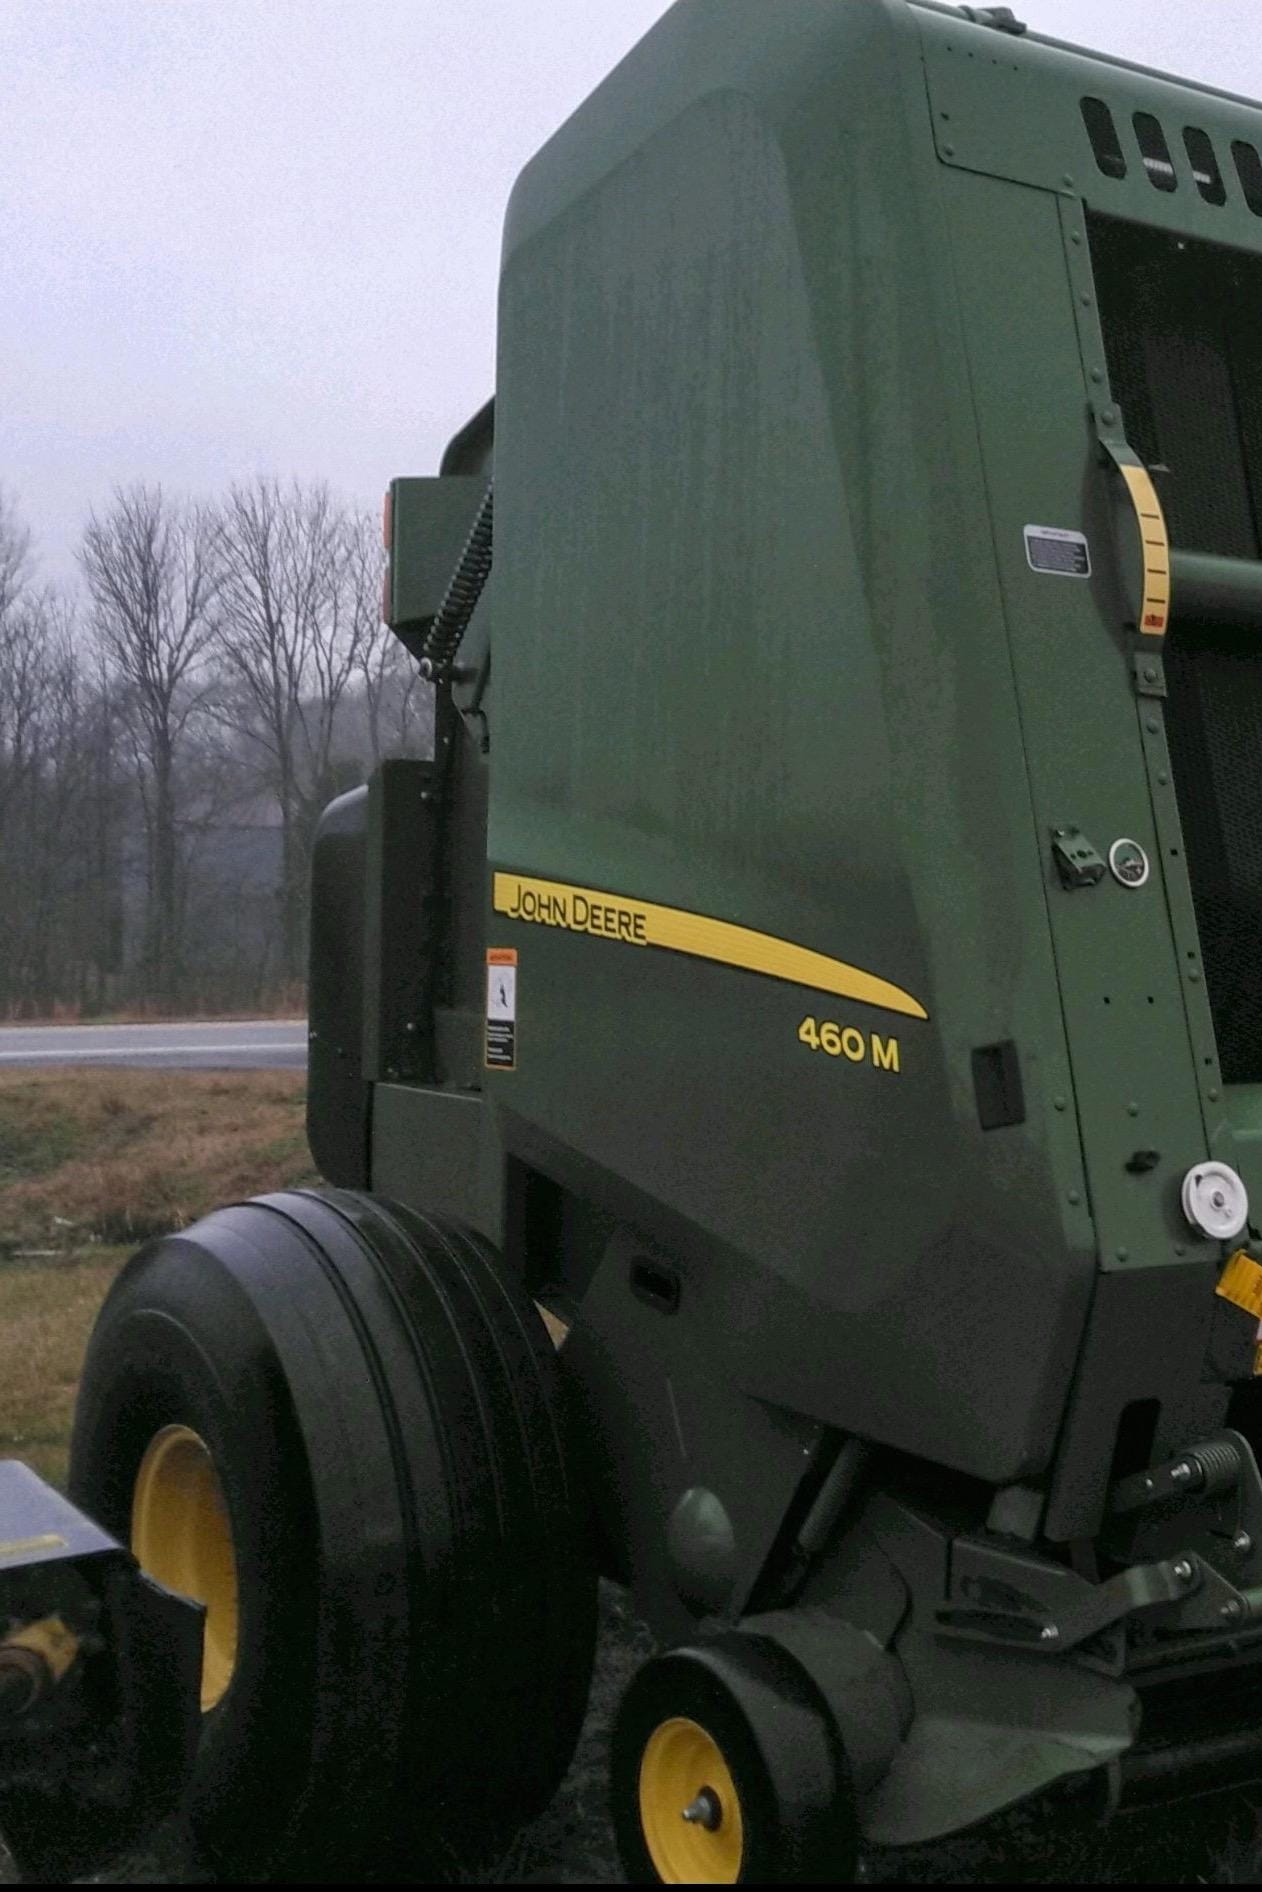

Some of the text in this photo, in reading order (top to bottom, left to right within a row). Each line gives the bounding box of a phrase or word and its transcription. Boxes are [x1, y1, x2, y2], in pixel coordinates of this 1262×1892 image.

[510, 884, 647, 940] JOHN DEERE
[798, 1015, 900, 1073] 460 M
